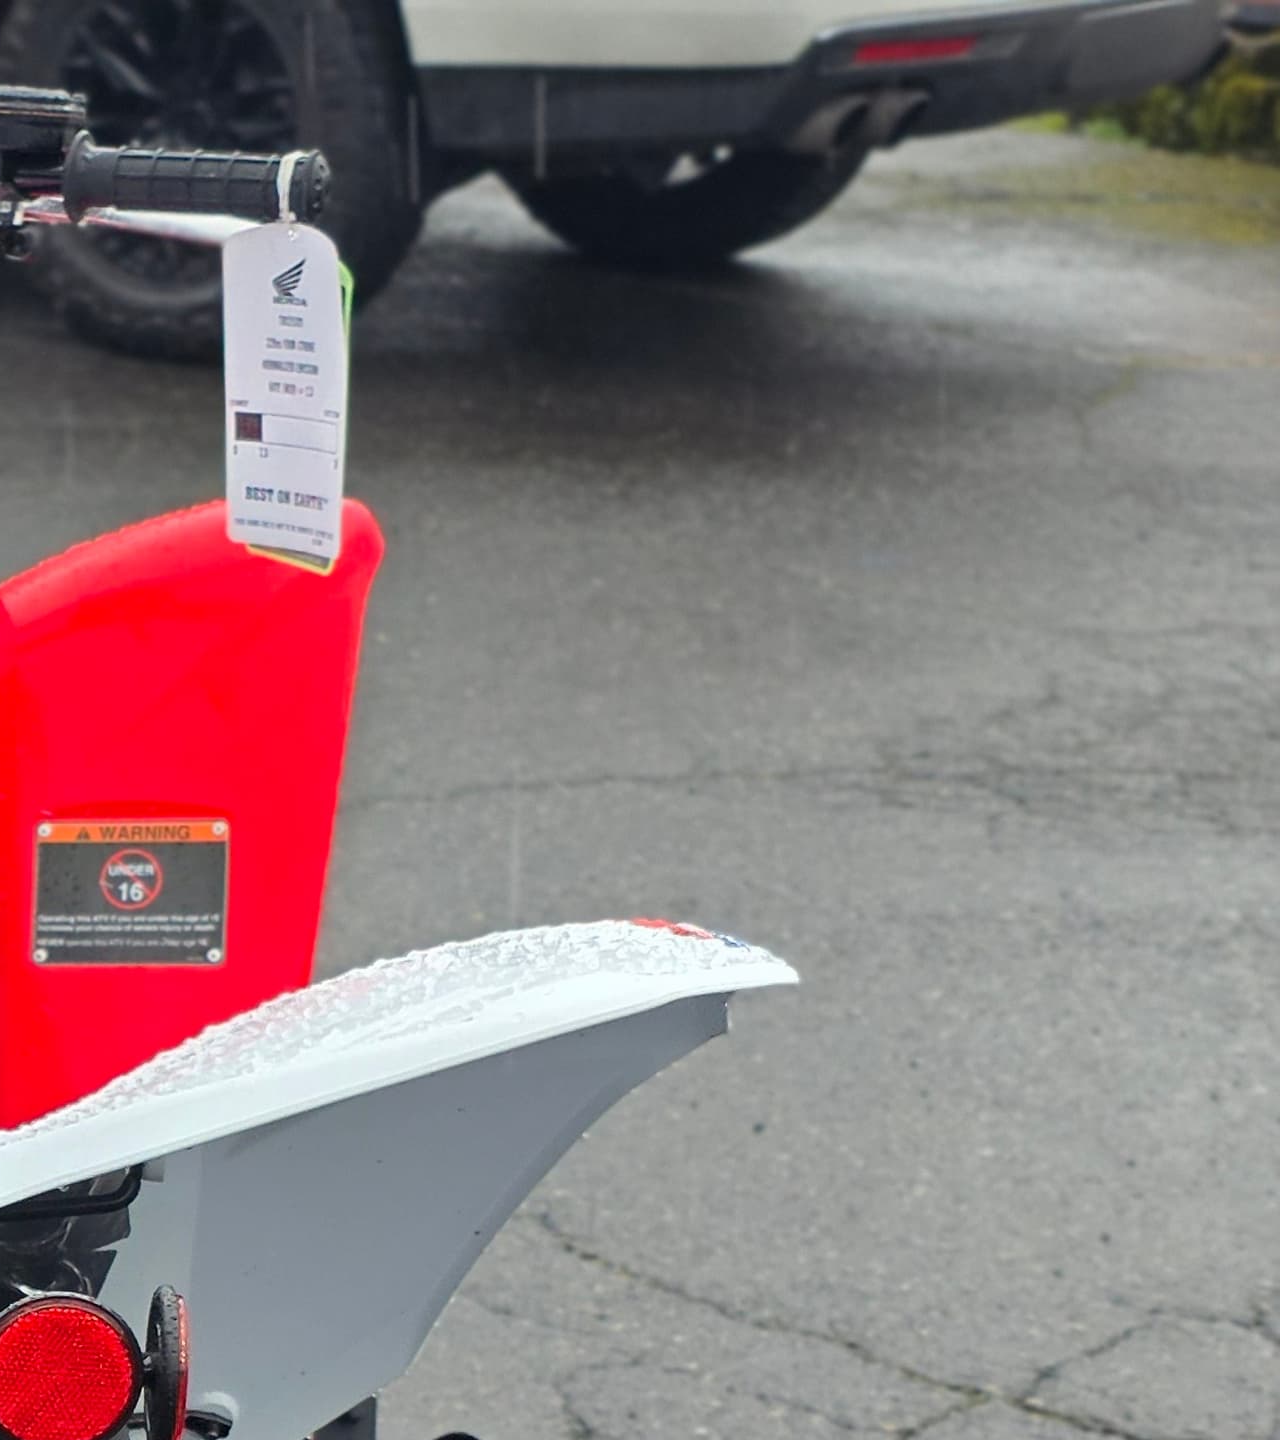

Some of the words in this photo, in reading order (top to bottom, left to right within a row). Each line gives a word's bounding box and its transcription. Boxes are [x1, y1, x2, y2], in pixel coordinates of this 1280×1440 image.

[99, 824, 190, 841] WARNING
[108, 863, 155, 878] UNDER
[118, 882, 144, 902] 16
